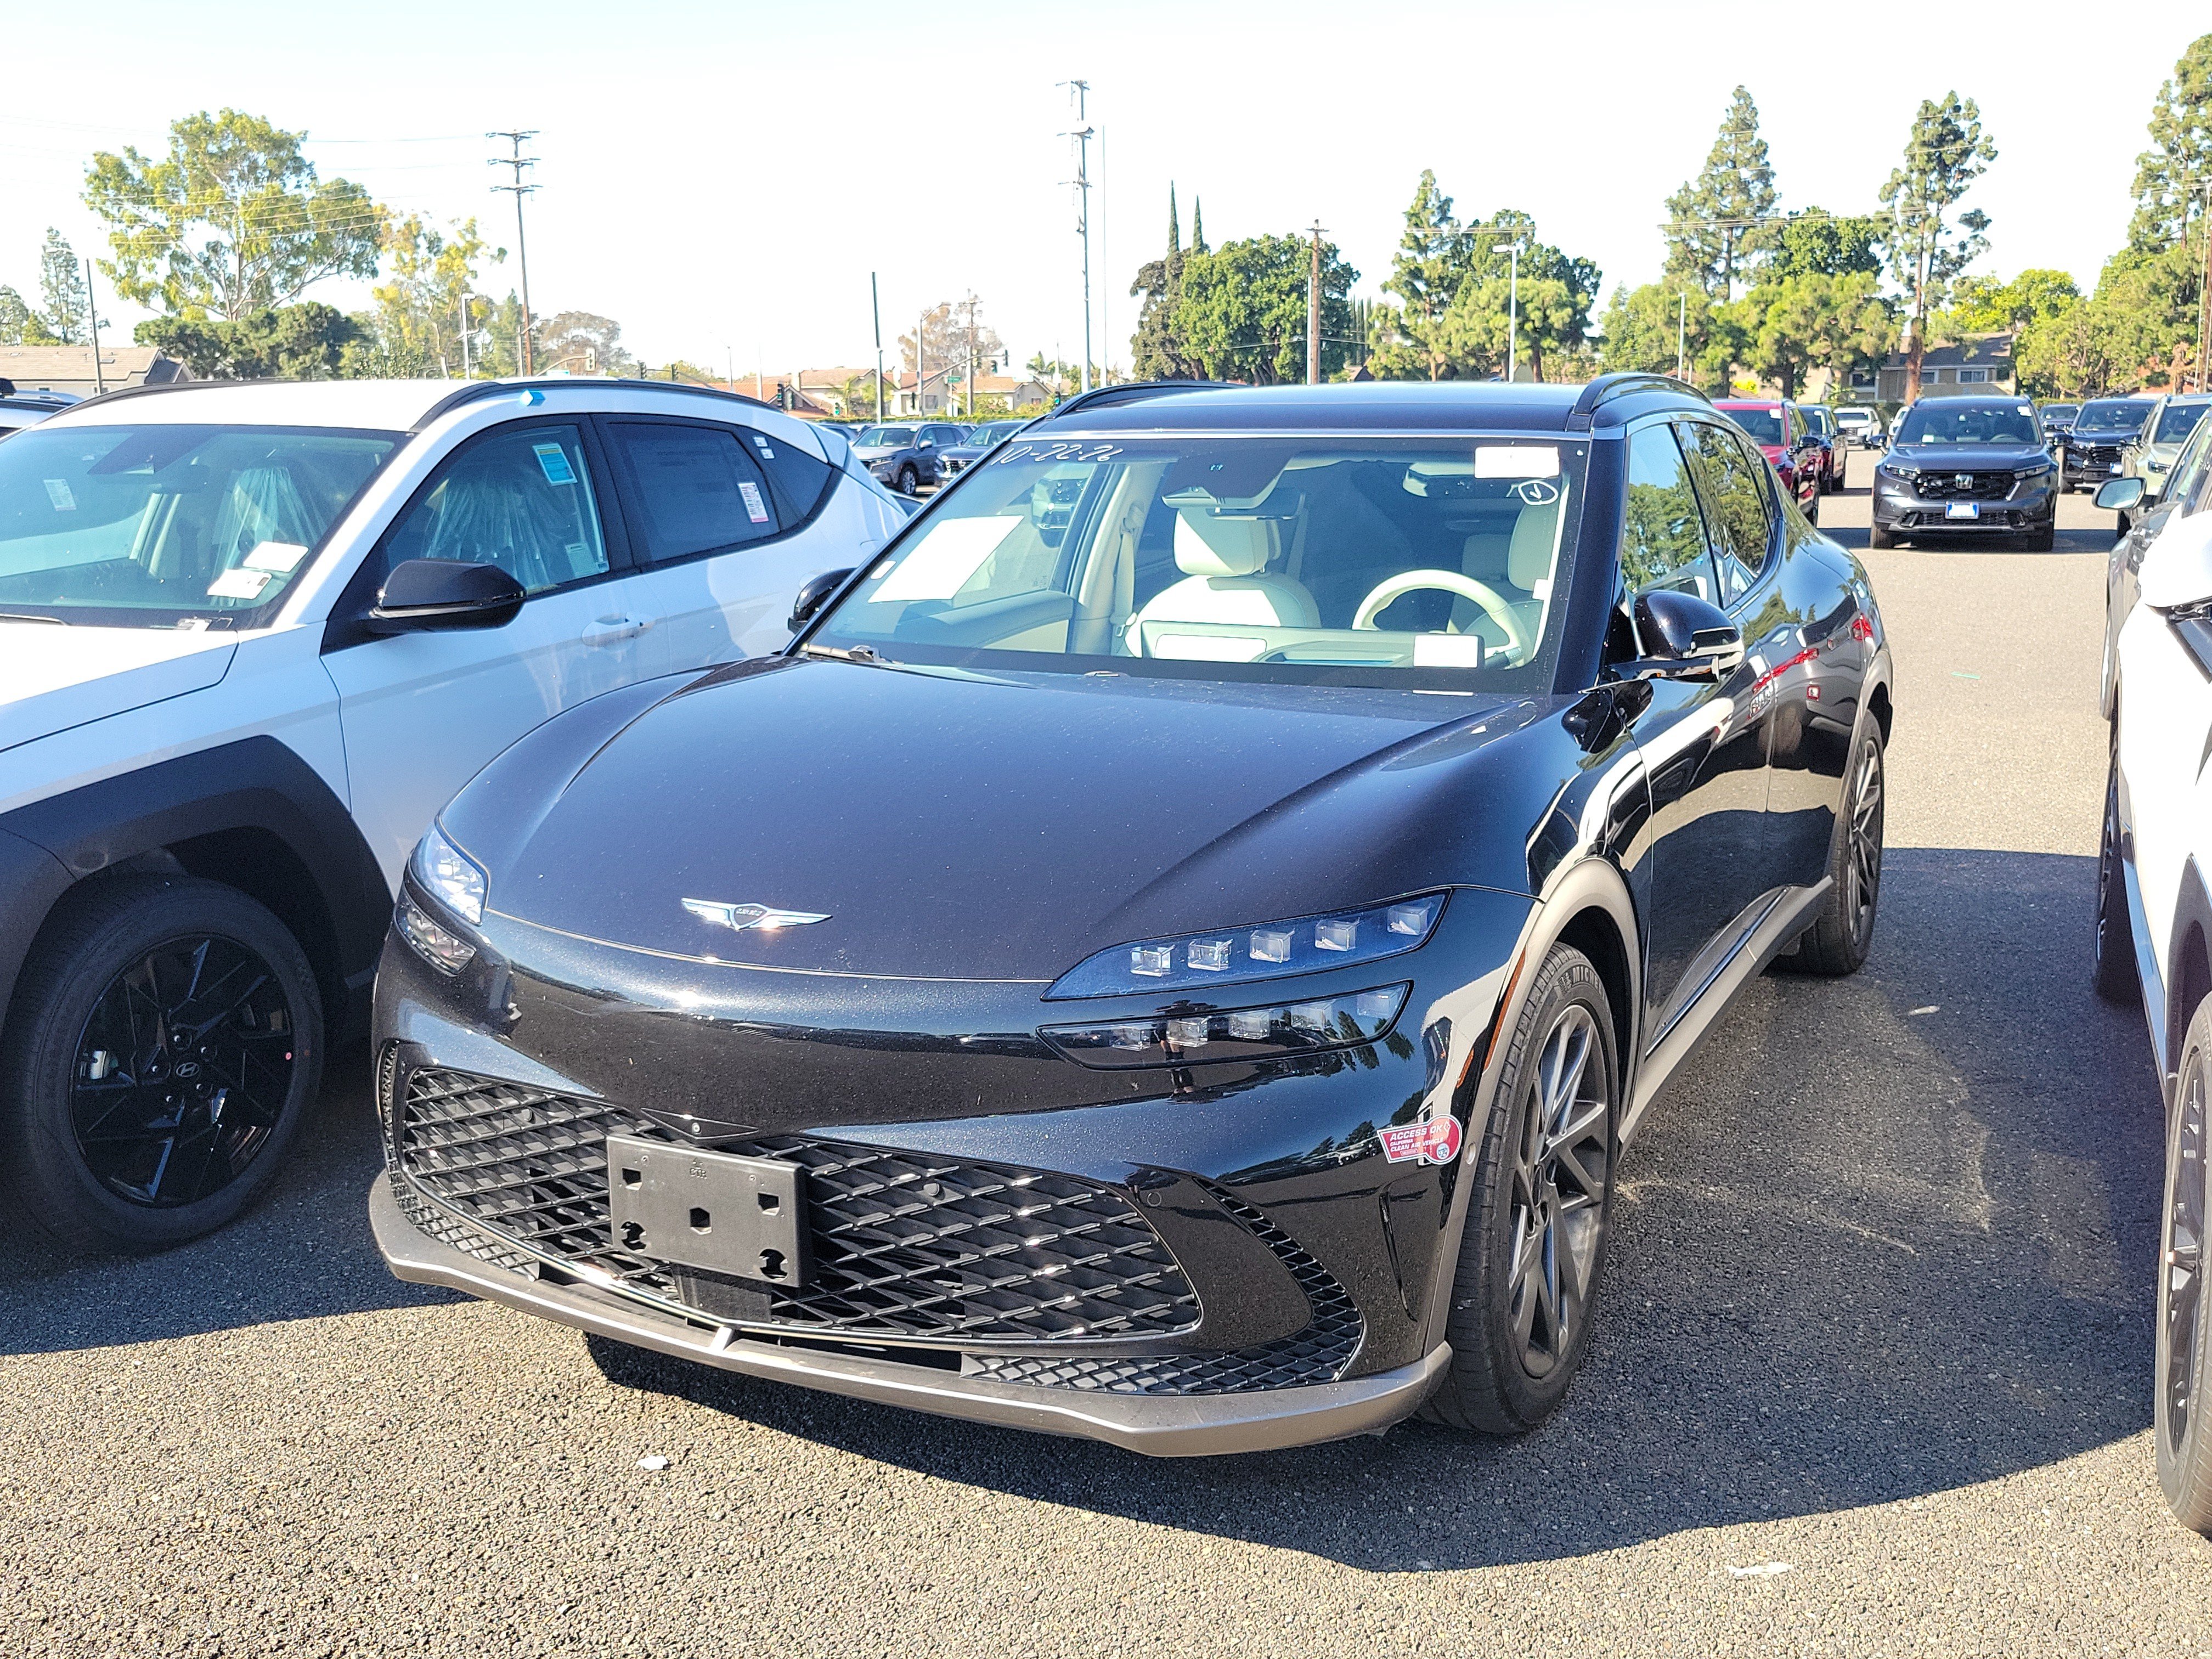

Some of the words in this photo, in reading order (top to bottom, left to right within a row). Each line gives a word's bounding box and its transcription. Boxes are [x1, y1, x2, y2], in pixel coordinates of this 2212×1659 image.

[1390, 1128, 1427, 1141] ACCESS
[1430, 1125, 1442, 1133] OK
[1423, 1137, 1443, 1146] VEHICLE
